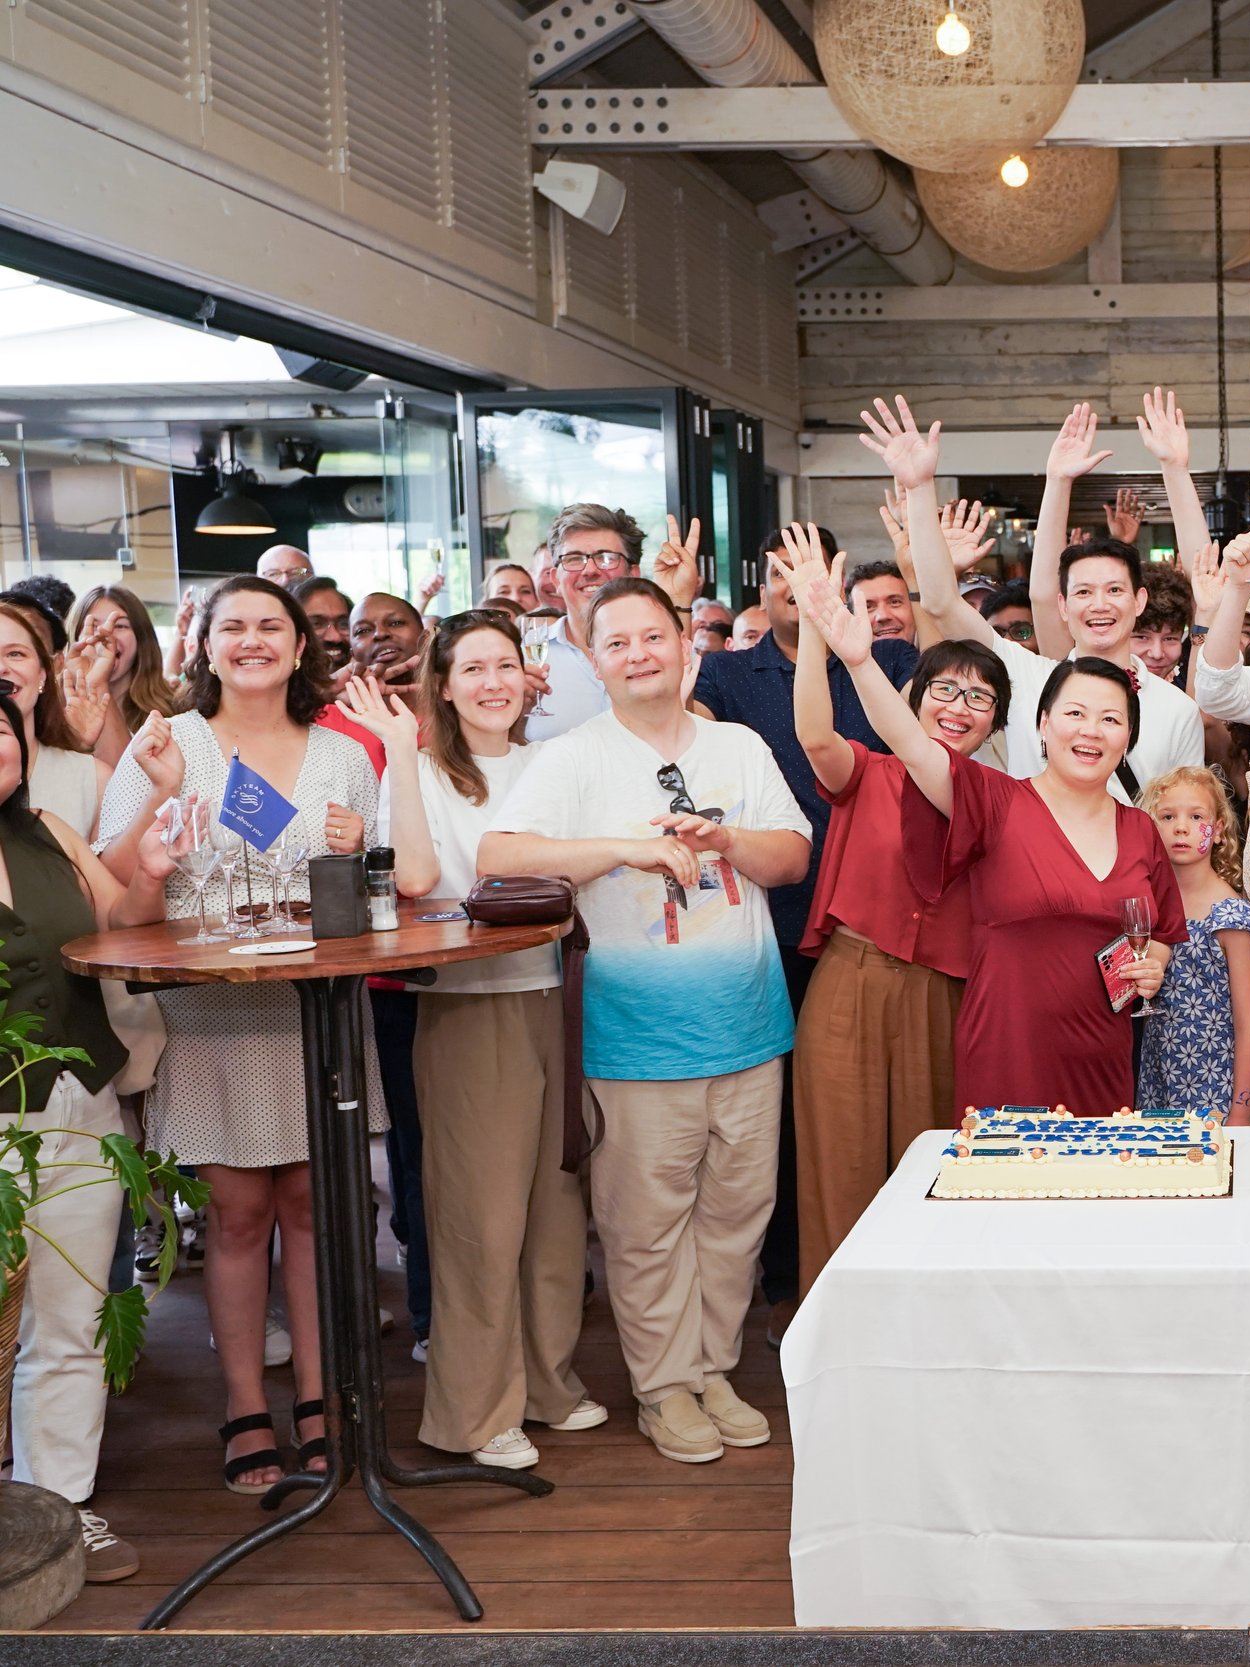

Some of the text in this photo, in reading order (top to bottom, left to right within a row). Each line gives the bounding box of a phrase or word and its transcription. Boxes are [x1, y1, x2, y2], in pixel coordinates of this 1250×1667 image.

[235, 815, 253, 829] about
[252, 827, 264, 837] you
[1022, 1133, 1190, 1142] SKYTEAM
